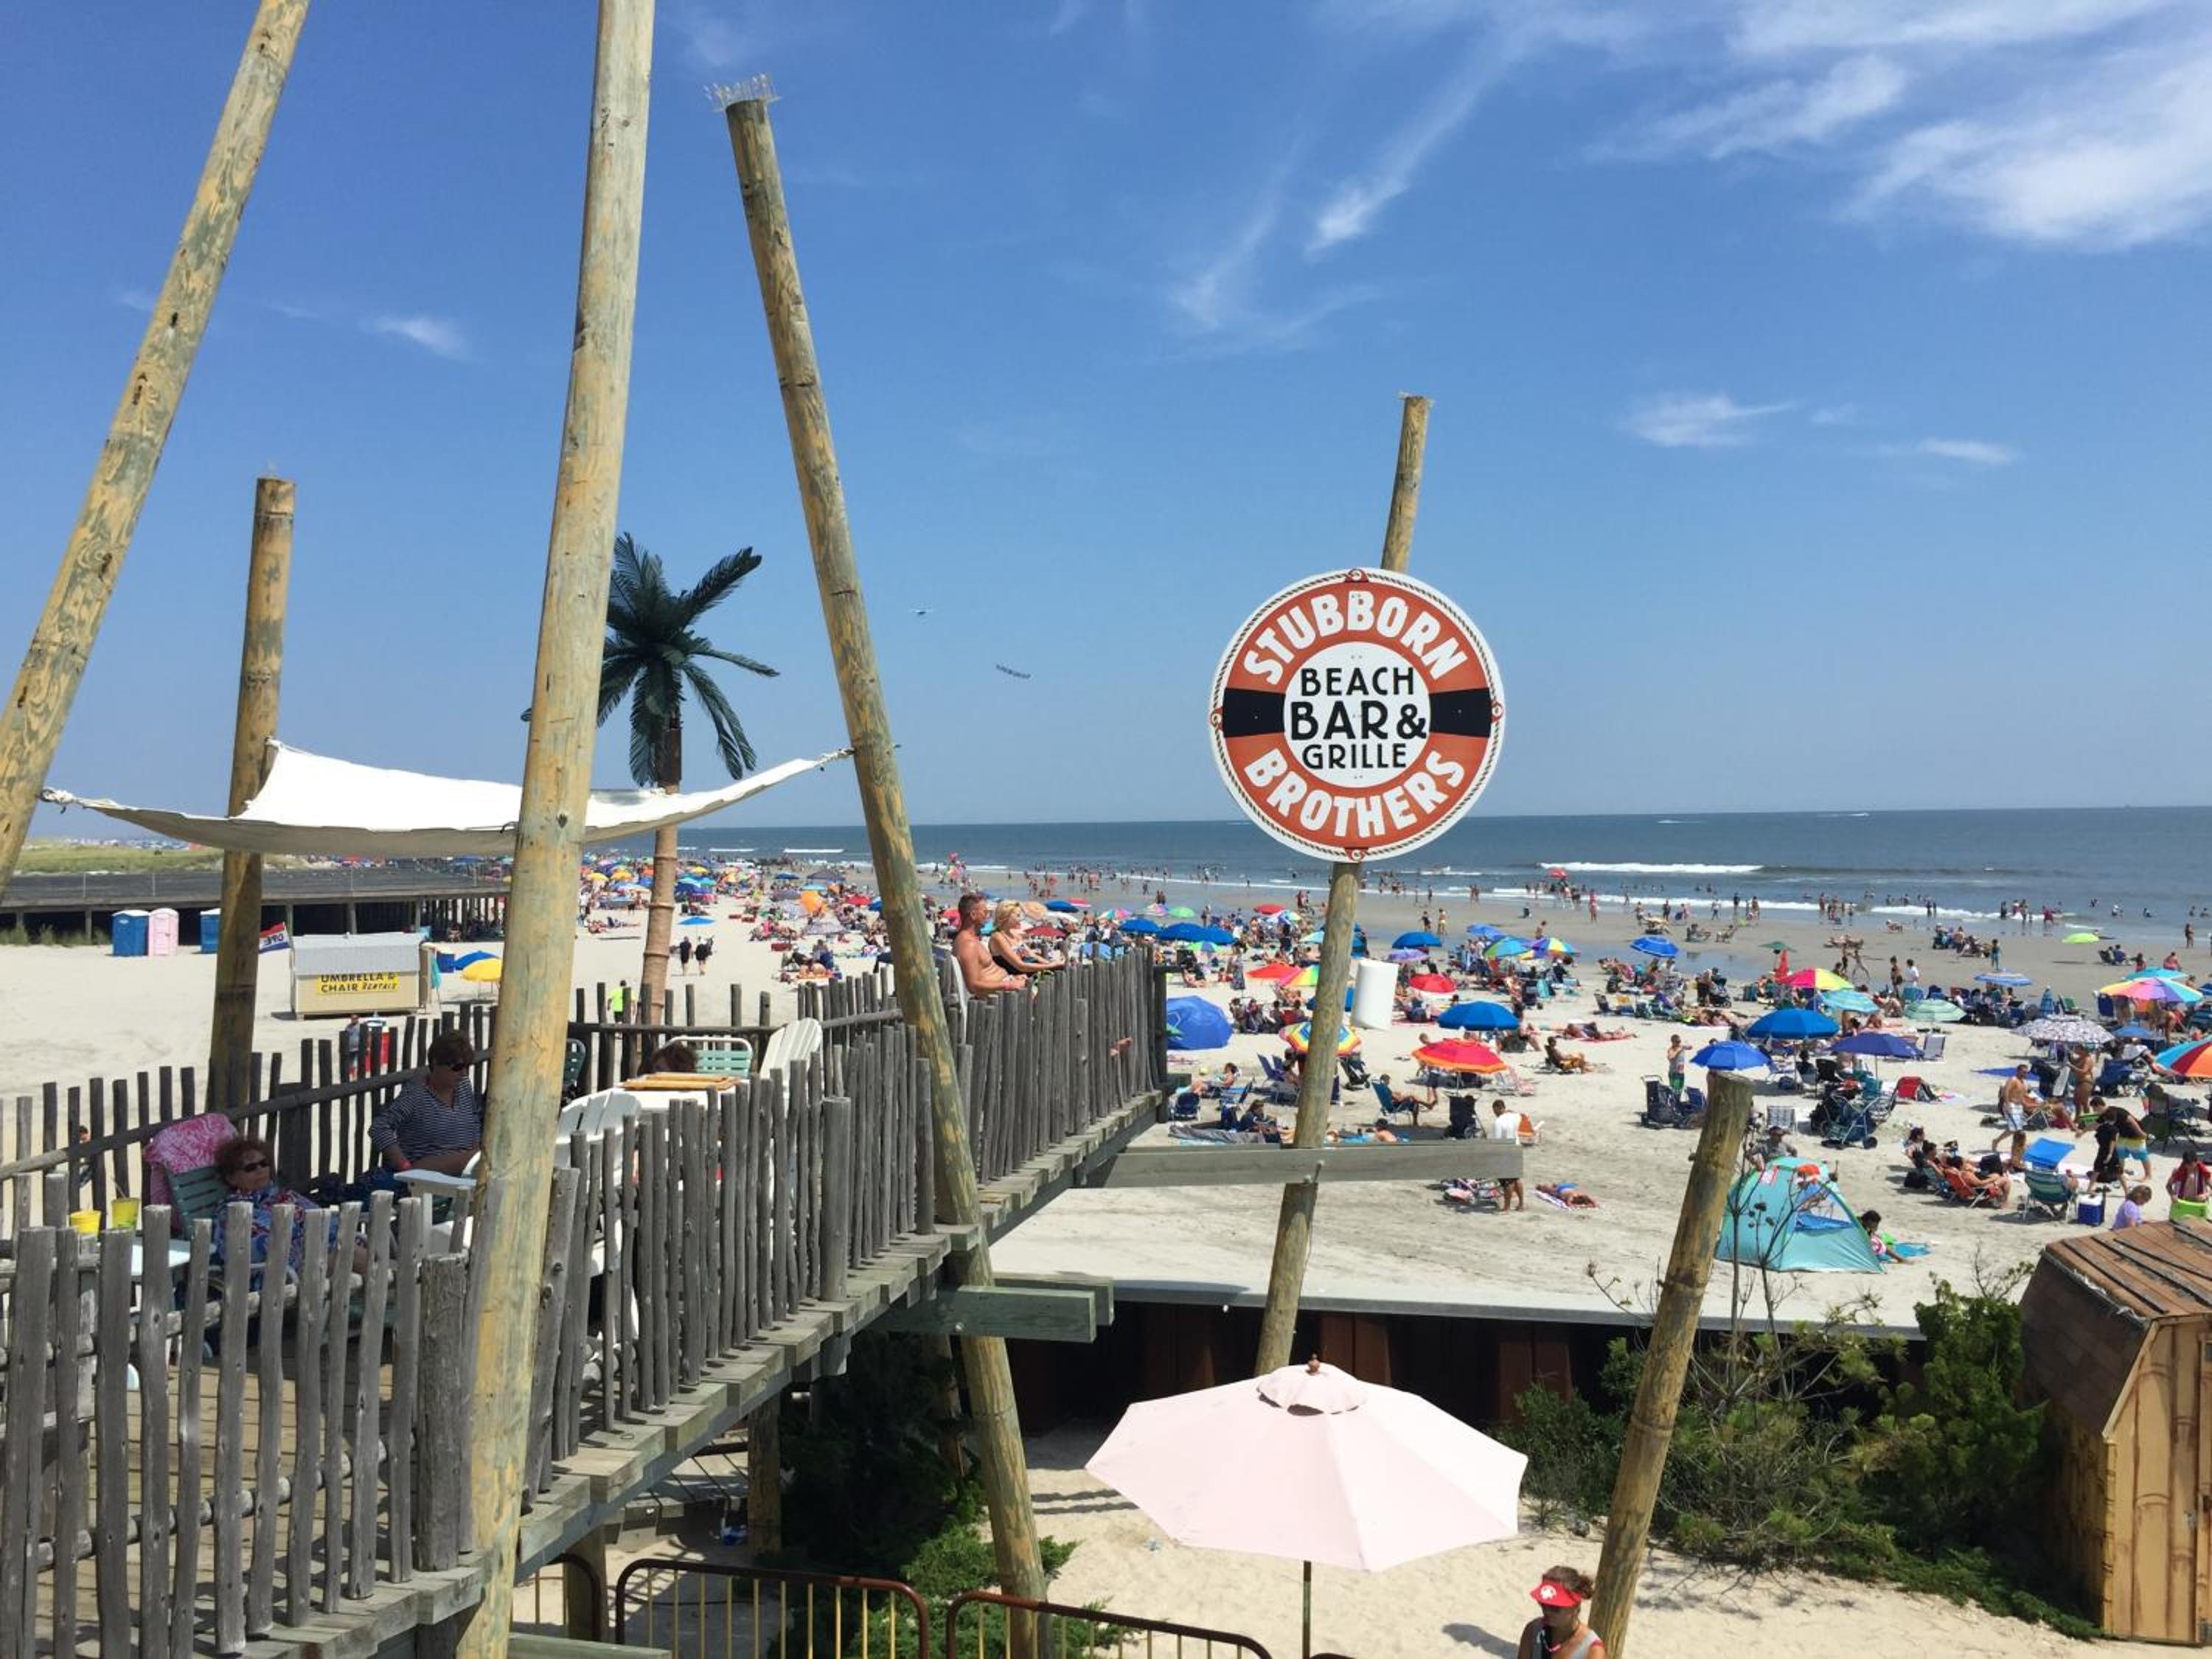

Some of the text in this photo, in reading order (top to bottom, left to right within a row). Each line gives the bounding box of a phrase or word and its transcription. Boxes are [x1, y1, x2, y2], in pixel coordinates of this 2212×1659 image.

[1244, 590, 1467, 685] STUBBORN
[1301, 667, 1413, 696] BEACH
[1290, 700, 1427, 740] BAR &
[1302, 743, 1407, 770] GRILLE
[1244, 748, 1464, 838] BROTHERS
[321, 973, 383, 983] UMBRELLA
[321, 984, 358, 992] CHAIR
